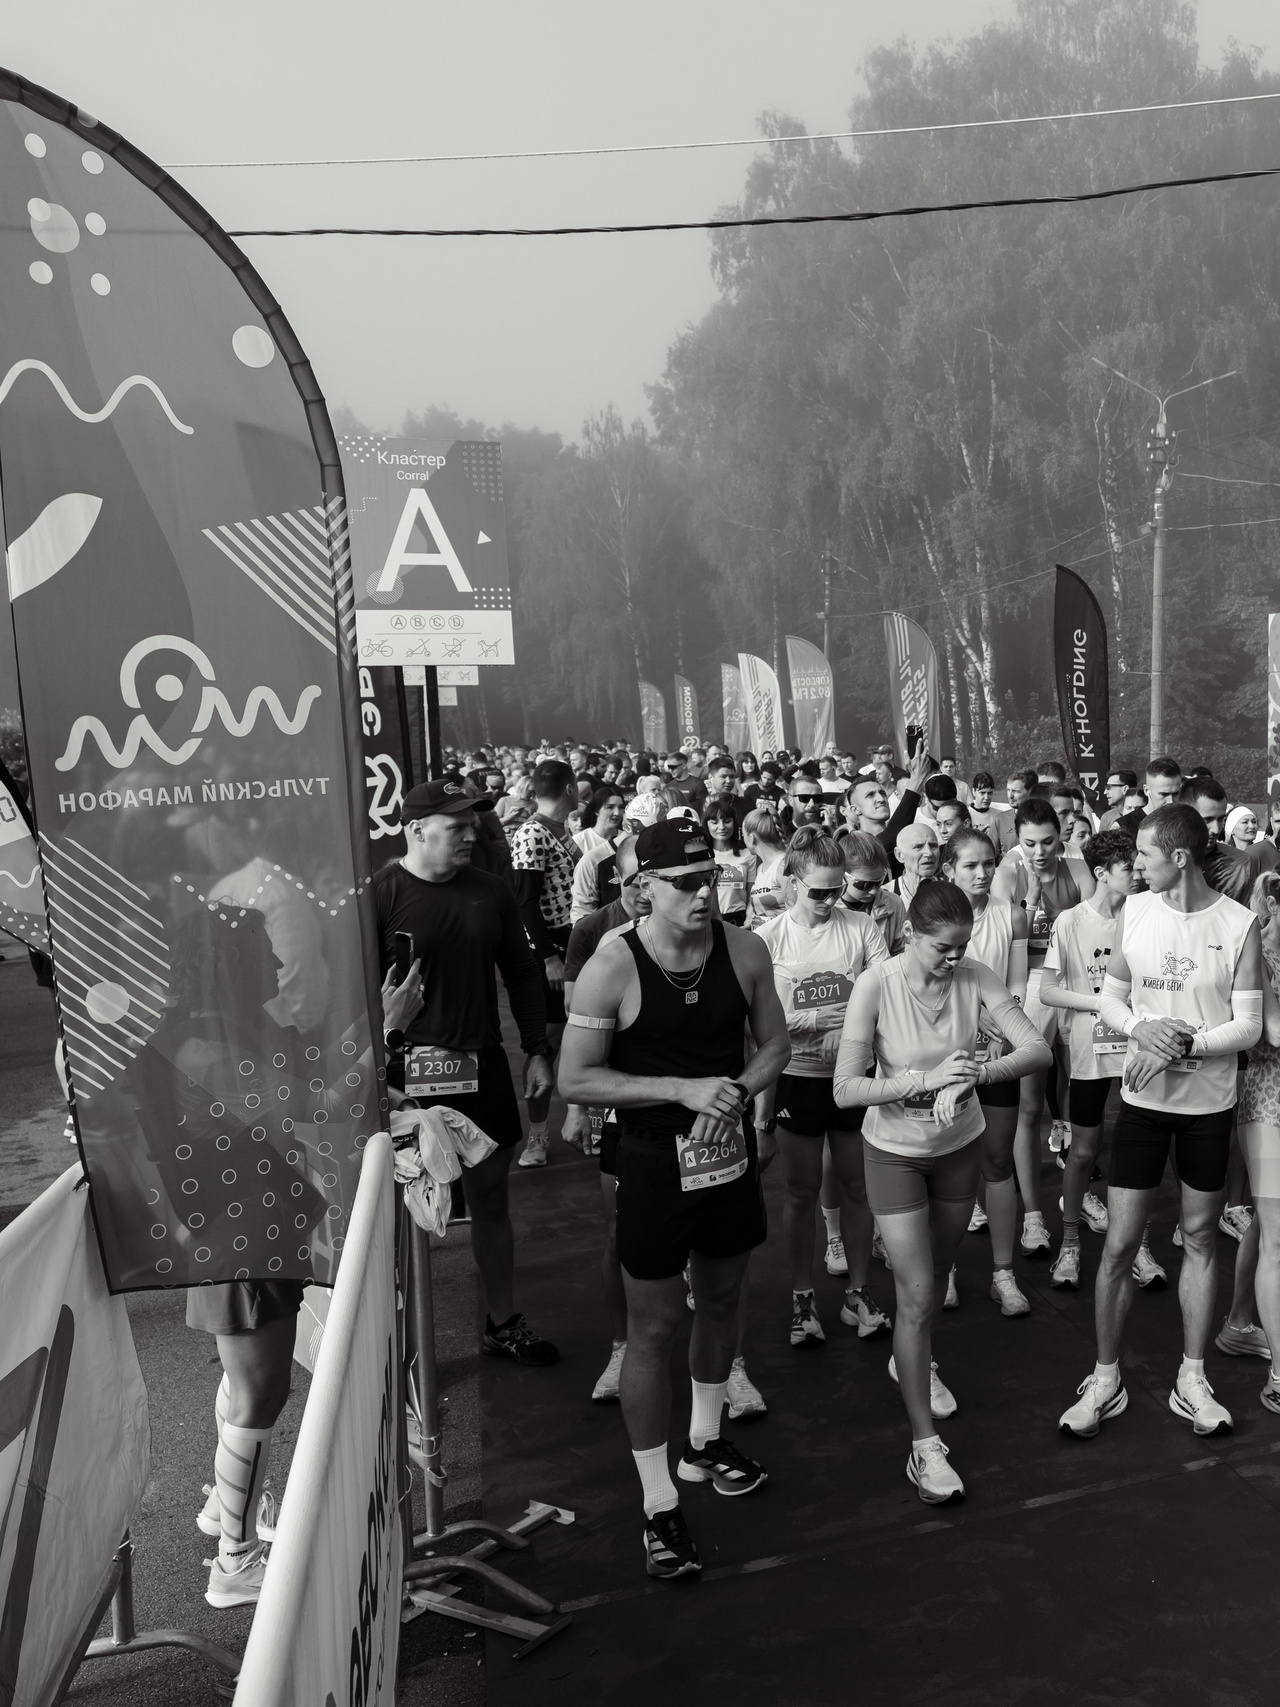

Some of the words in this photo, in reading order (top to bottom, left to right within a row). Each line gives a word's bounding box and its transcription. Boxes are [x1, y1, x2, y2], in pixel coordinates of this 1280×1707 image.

[377, 450, 446, 469] Кластер
[396, 470, 429, 481] Corral
[376, 487, 474, 593] A
[809, 983, 841, 1000] 2071
[1142, 978, 1164, 991] ЖИВЕЙ
[1166, 980, 1184, 992] БЕГИ!
[424, 1060, 462, 1075] 2307
[698, 1139, 738, 1164] 2264
